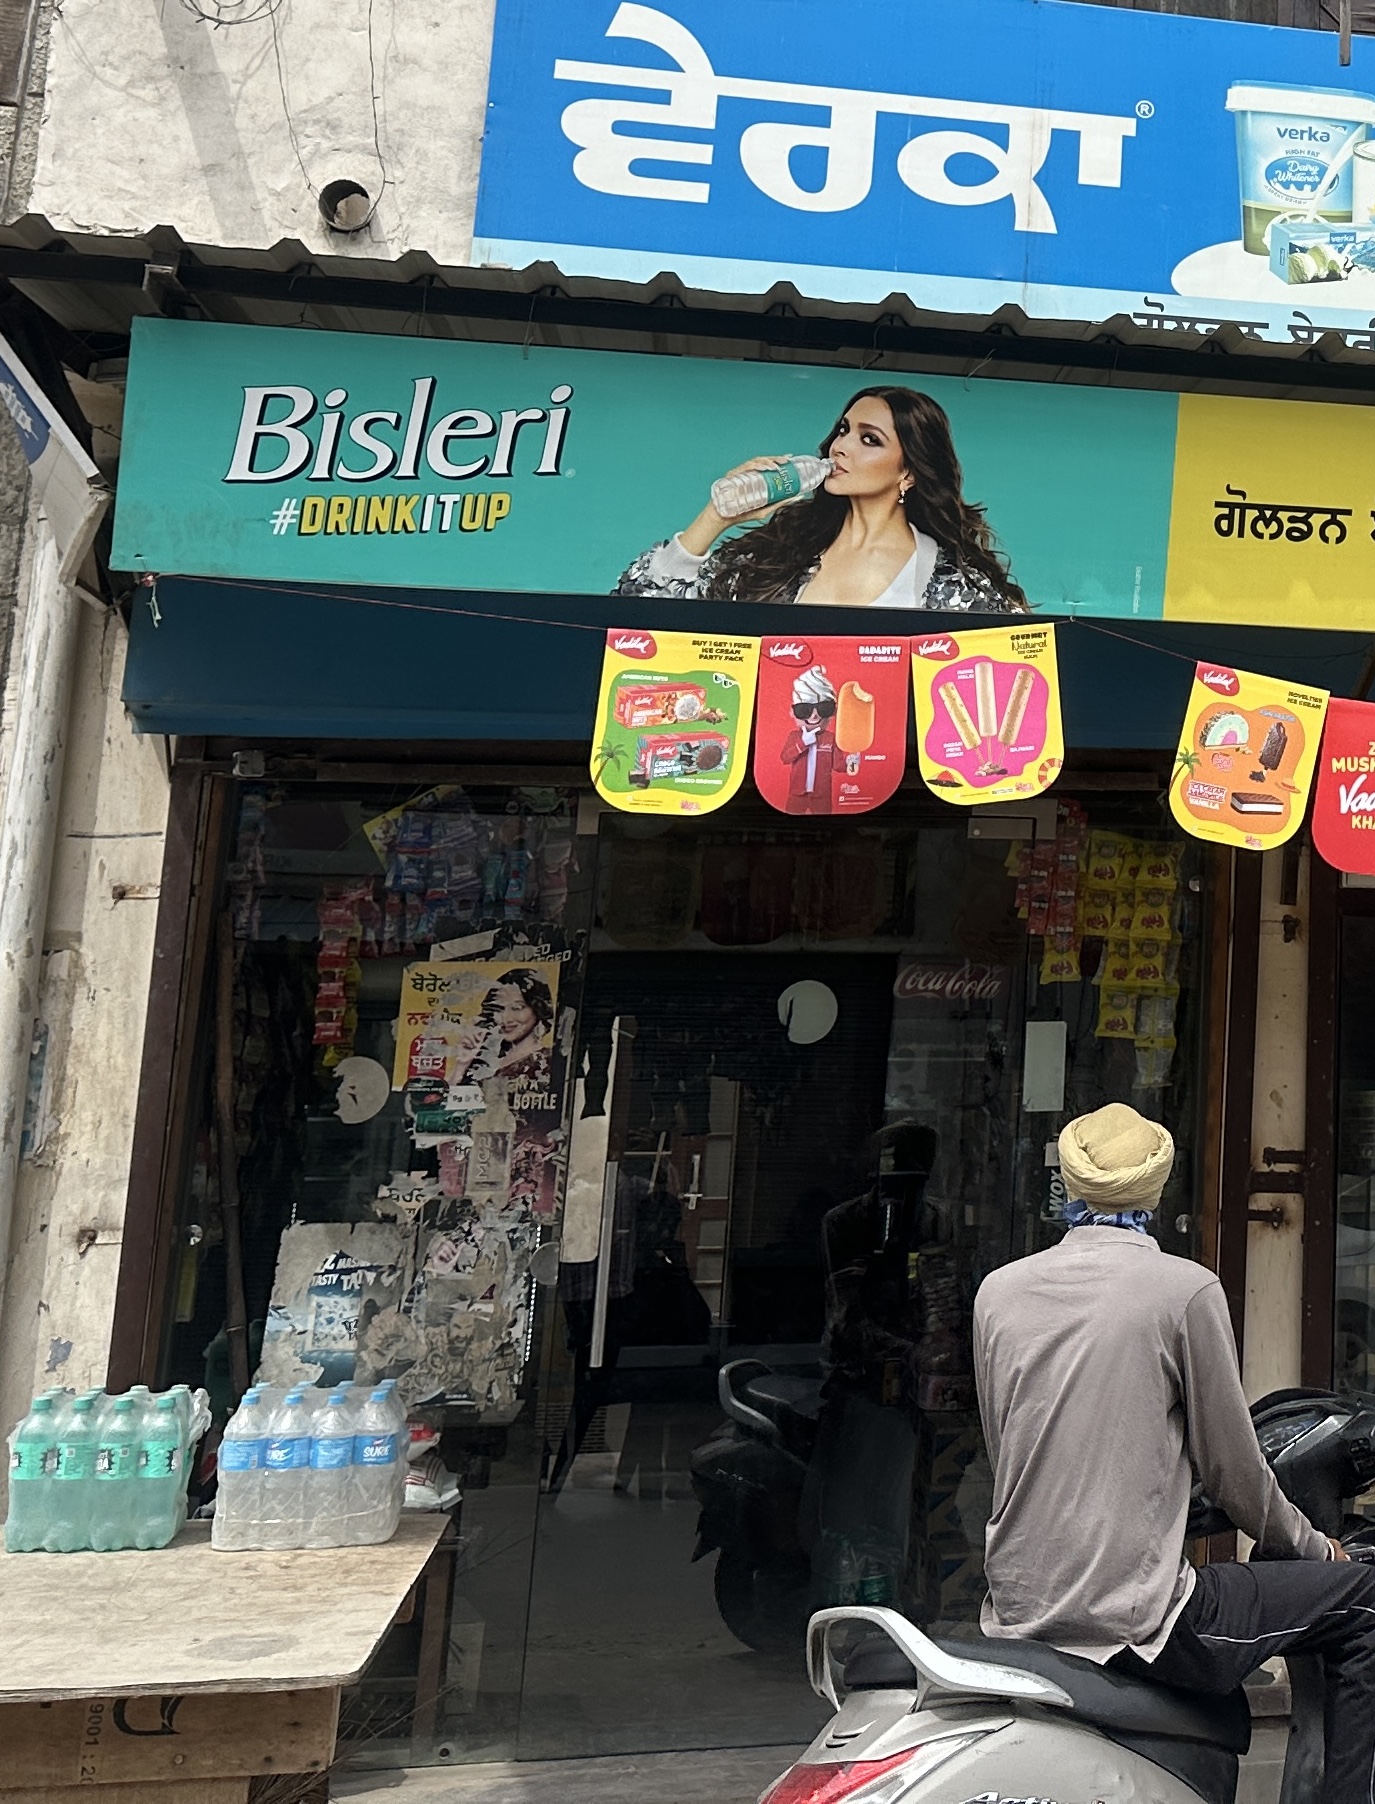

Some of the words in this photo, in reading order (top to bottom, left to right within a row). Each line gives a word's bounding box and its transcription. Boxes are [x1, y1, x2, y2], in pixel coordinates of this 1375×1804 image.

[553, 1, 1137, 234] ਵੇਰਕਾ
[1276, 126, 1330, 143] verka
[222, 376, 573, 484] Bisleri
[269, 491, 512, 537] #DRINKITUP
[1214, 483, 1352, 546] ਗੋਲਡਨ
[614, 635, 652, 654] Vadilal
[769, 643, 804, 660] Vadilal
[918, 639, 953, 655] Vadilal
[1011, 639, 1047, 652] Natural
[1203, 670, 1235, 691] Vadilal
[513, 1092, 557, 1110] BOTTLE
[363, 1445, 391, 1458] SURE
[84, 1703, 104, 1747] 9001
